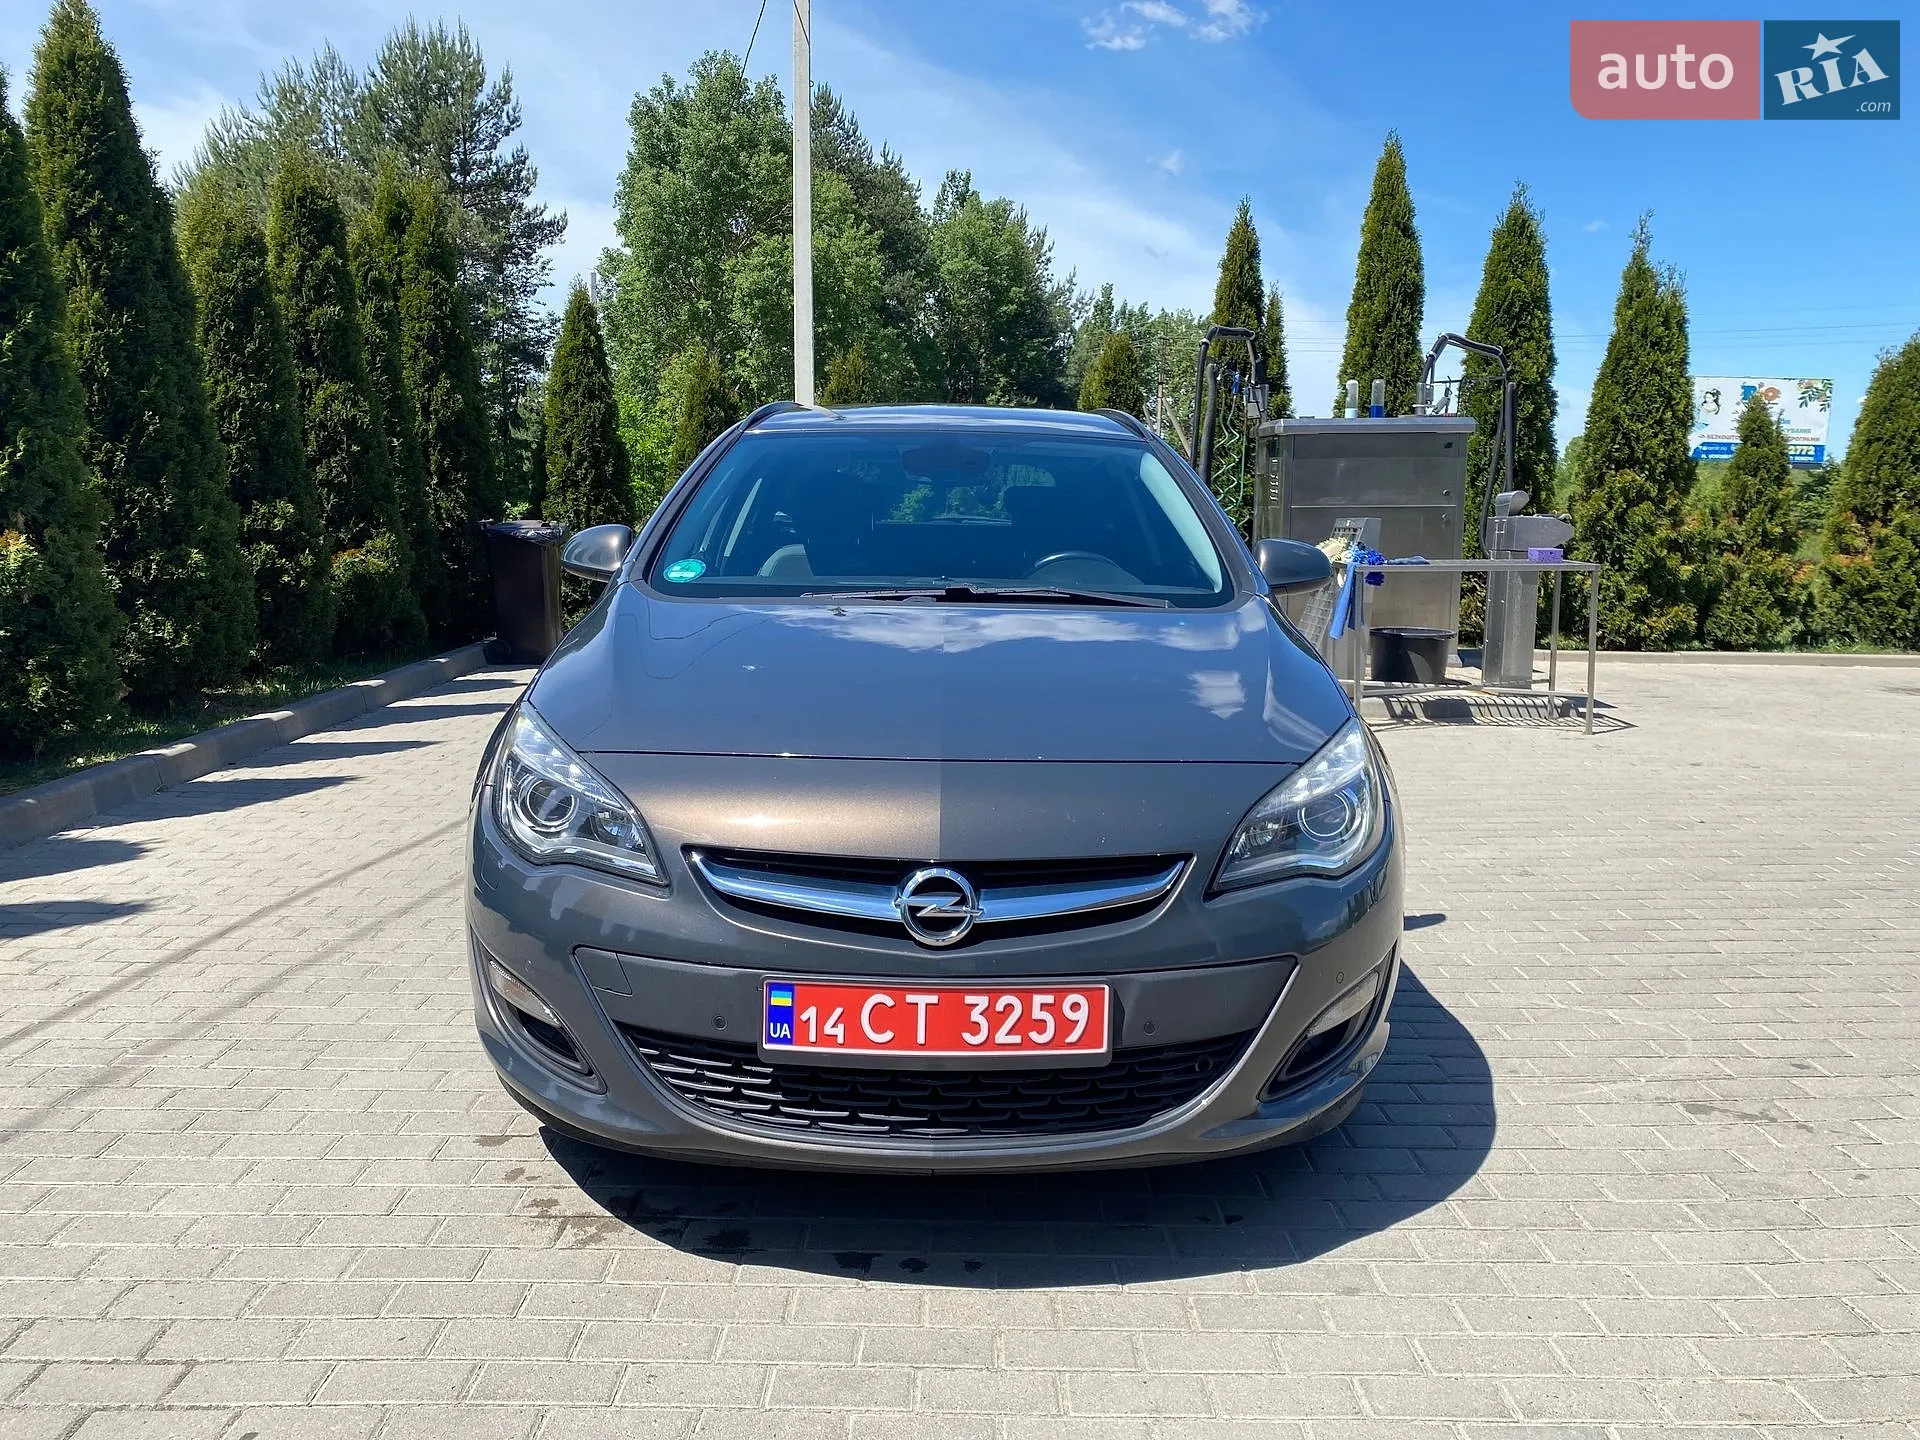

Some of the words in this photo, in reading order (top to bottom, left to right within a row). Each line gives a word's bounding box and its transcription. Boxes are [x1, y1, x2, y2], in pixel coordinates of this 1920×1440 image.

[769, 1022, 791, 1039] UA
[800, 1005, 845, 1044] 14
[860, 993, 939, 1045] CT
[961, 993, 1090, 1045] 3259
